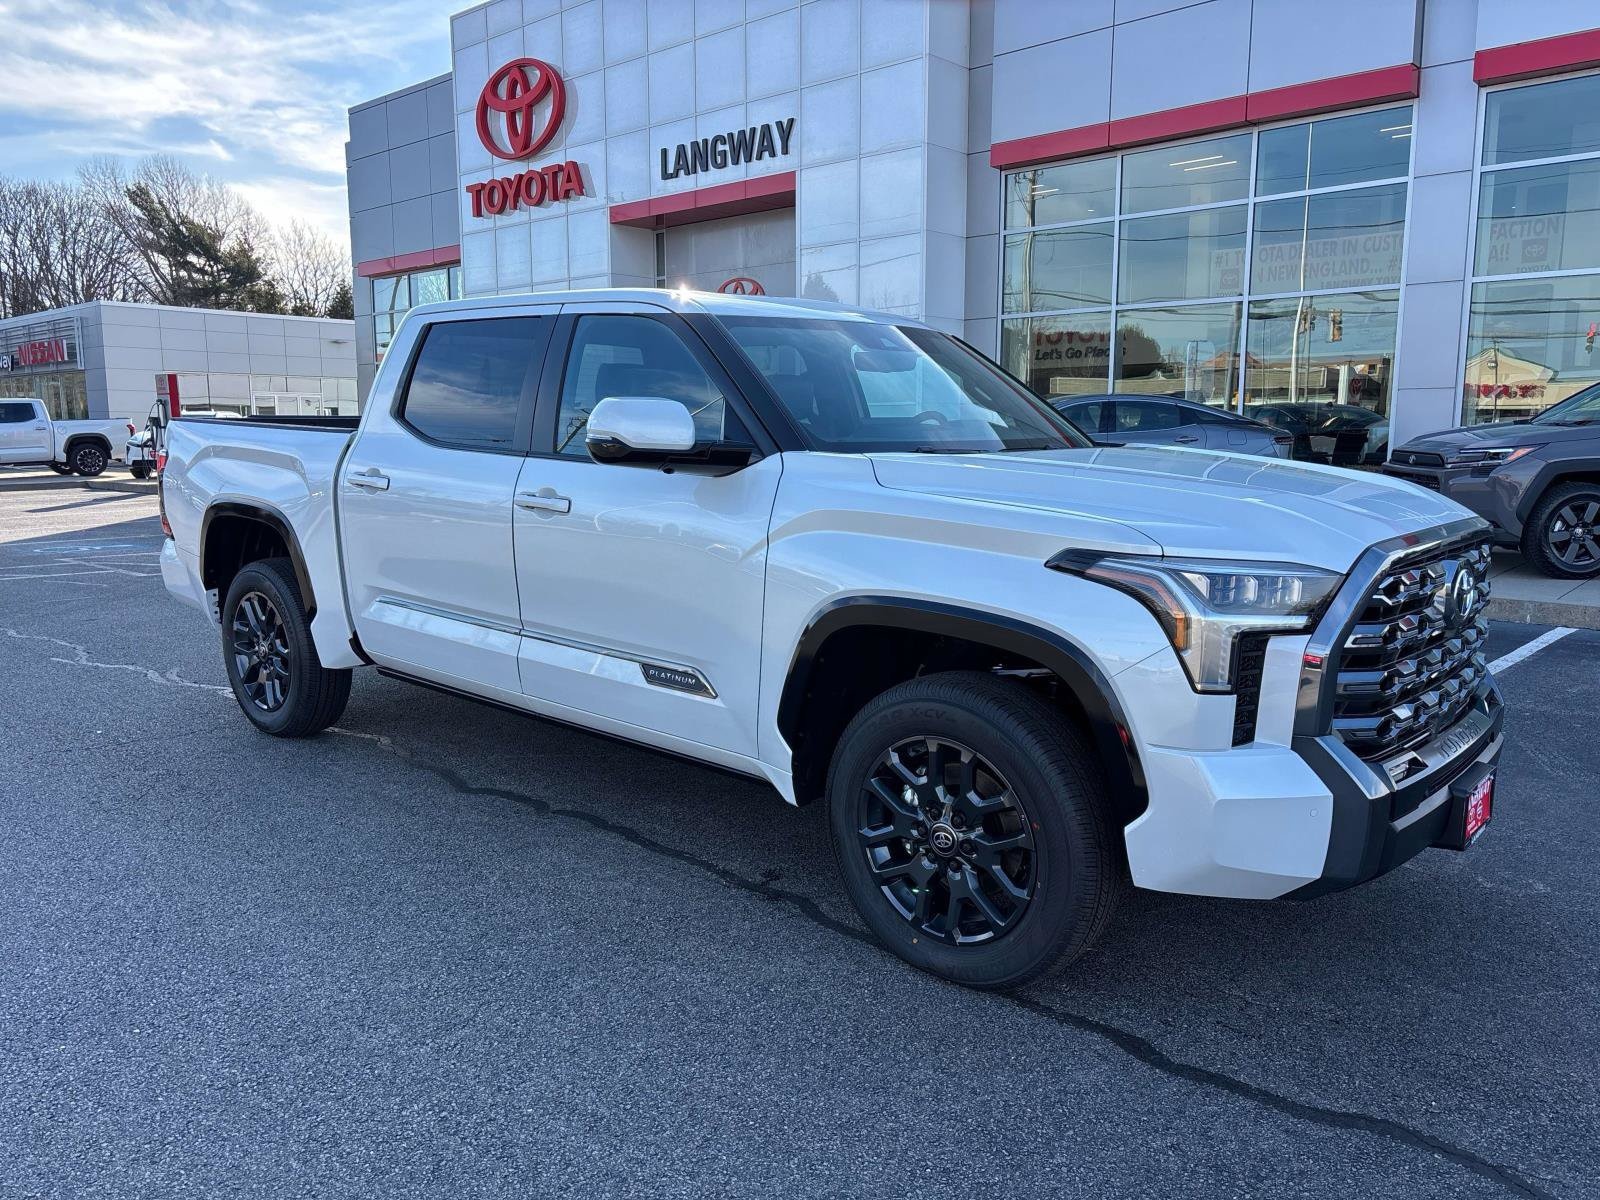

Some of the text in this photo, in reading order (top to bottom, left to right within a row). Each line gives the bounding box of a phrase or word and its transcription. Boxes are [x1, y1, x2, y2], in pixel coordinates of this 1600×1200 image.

[660, 117, 796, 181] LANGWAY
[466, 160, 585, 218] TOYOTA
[1342, 238, 1358, 256] IN
[1268, 262, 1300, 283] NEW
[17, 338, 67, 366] NISSAN
[1035, 349, 1062, 361] Let's
[1065, 347, 1082, 359] Go
[649, 669, 696, 685] PLATINUM
